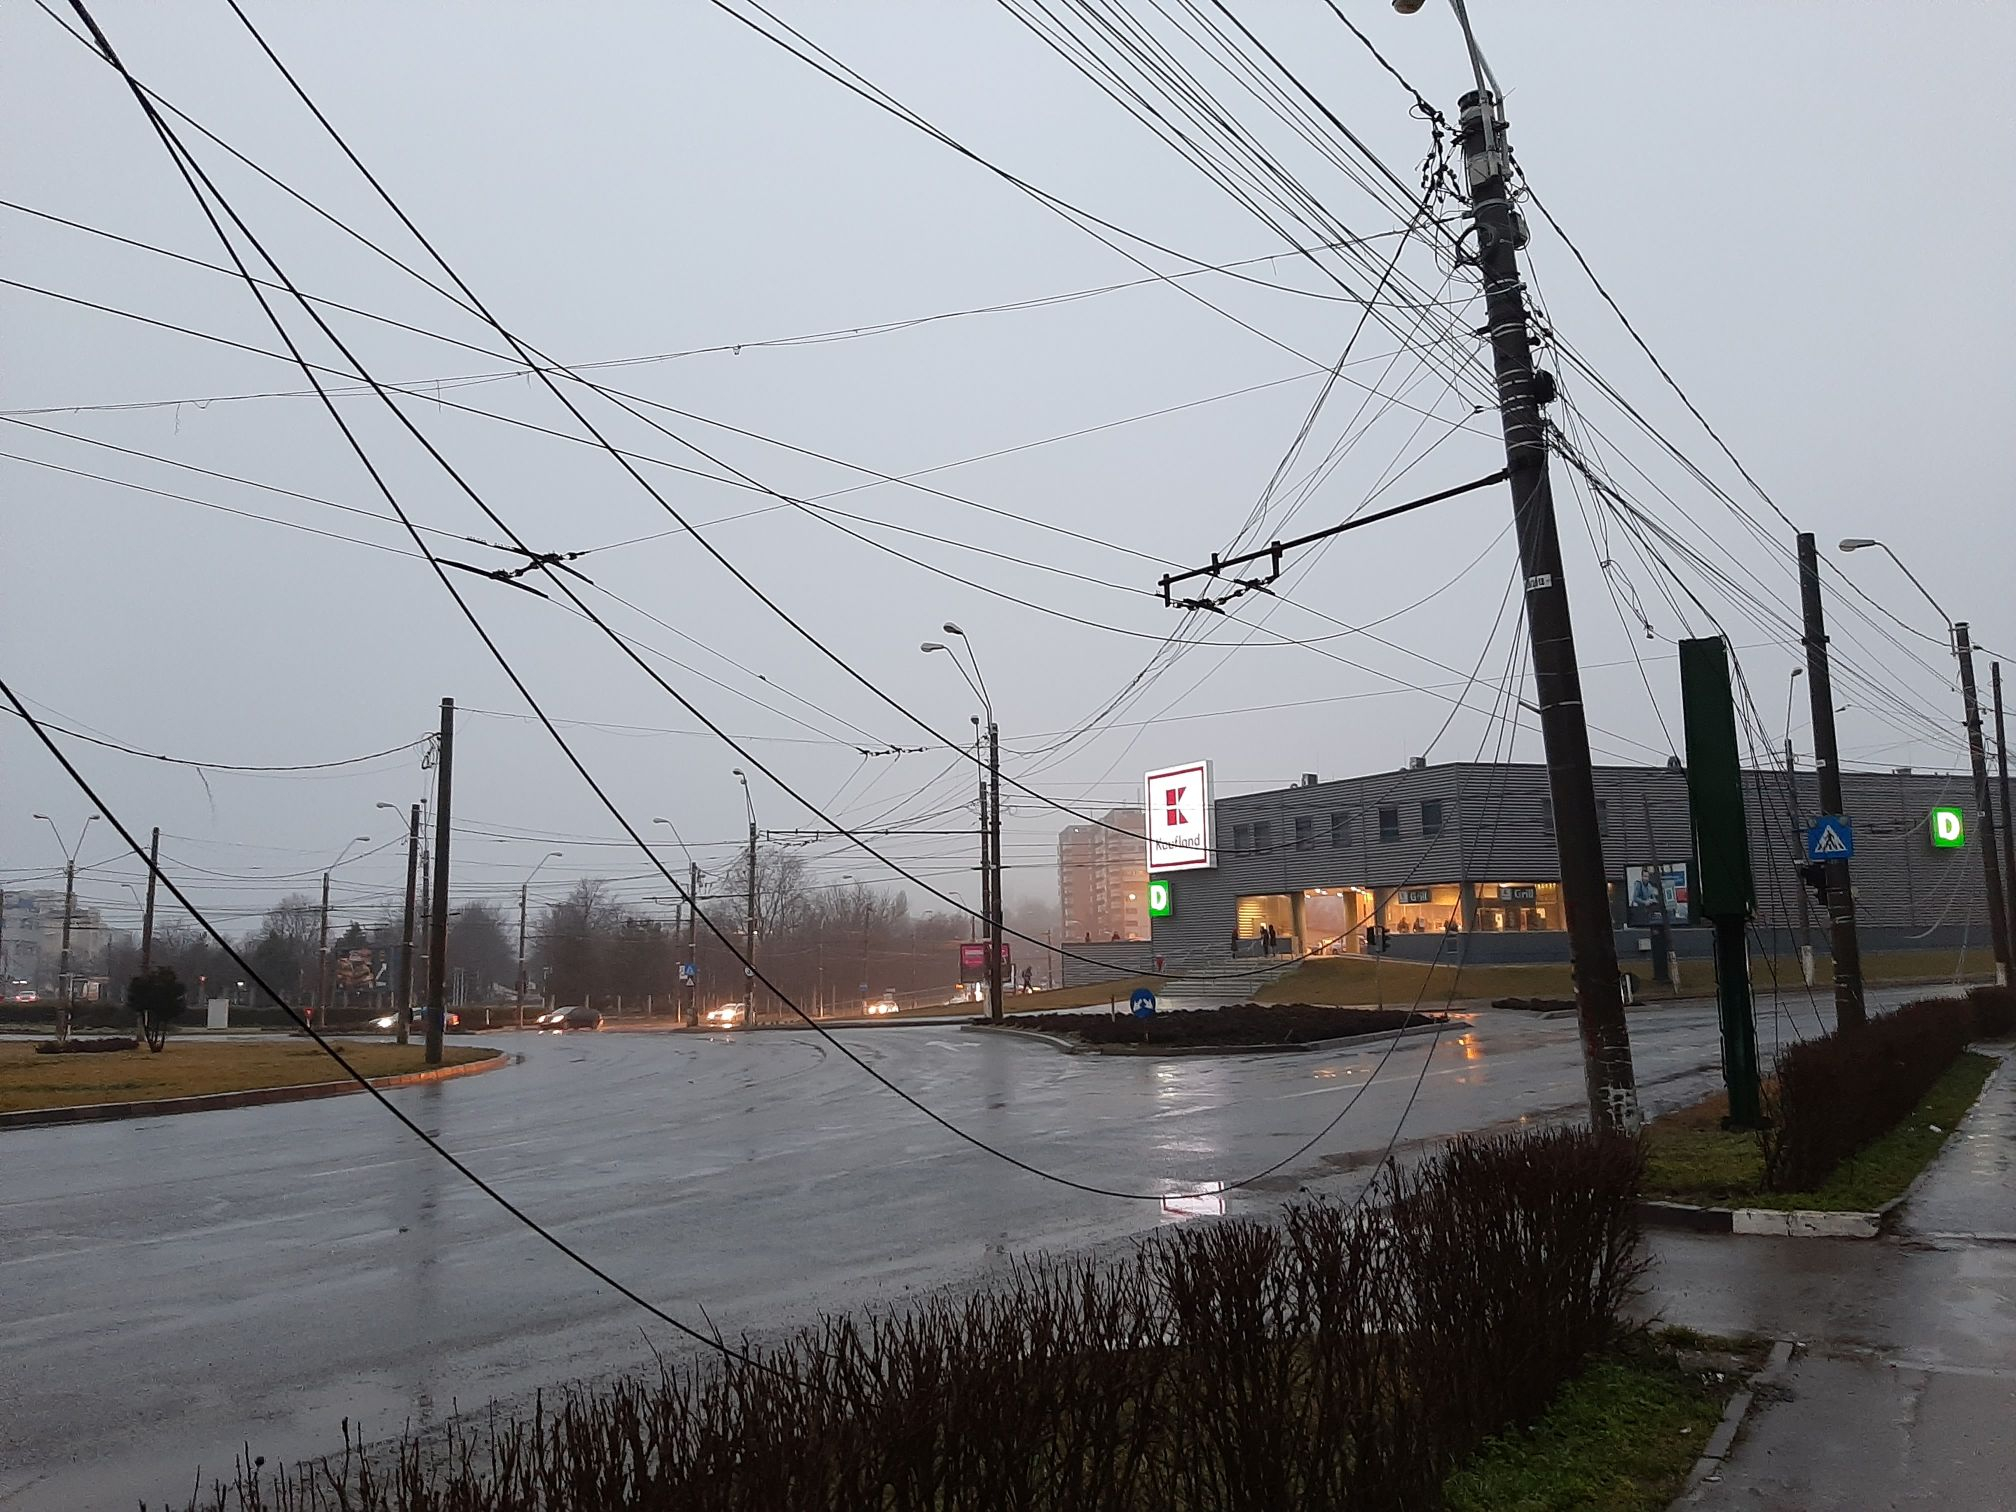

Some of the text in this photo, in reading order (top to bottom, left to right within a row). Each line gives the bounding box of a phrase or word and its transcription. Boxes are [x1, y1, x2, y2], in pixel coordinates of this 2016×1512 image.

[1166, 786, 1189, 826] K
[1936, 811, 1960, 841] D
[1150, 885, 1167, 910] D
